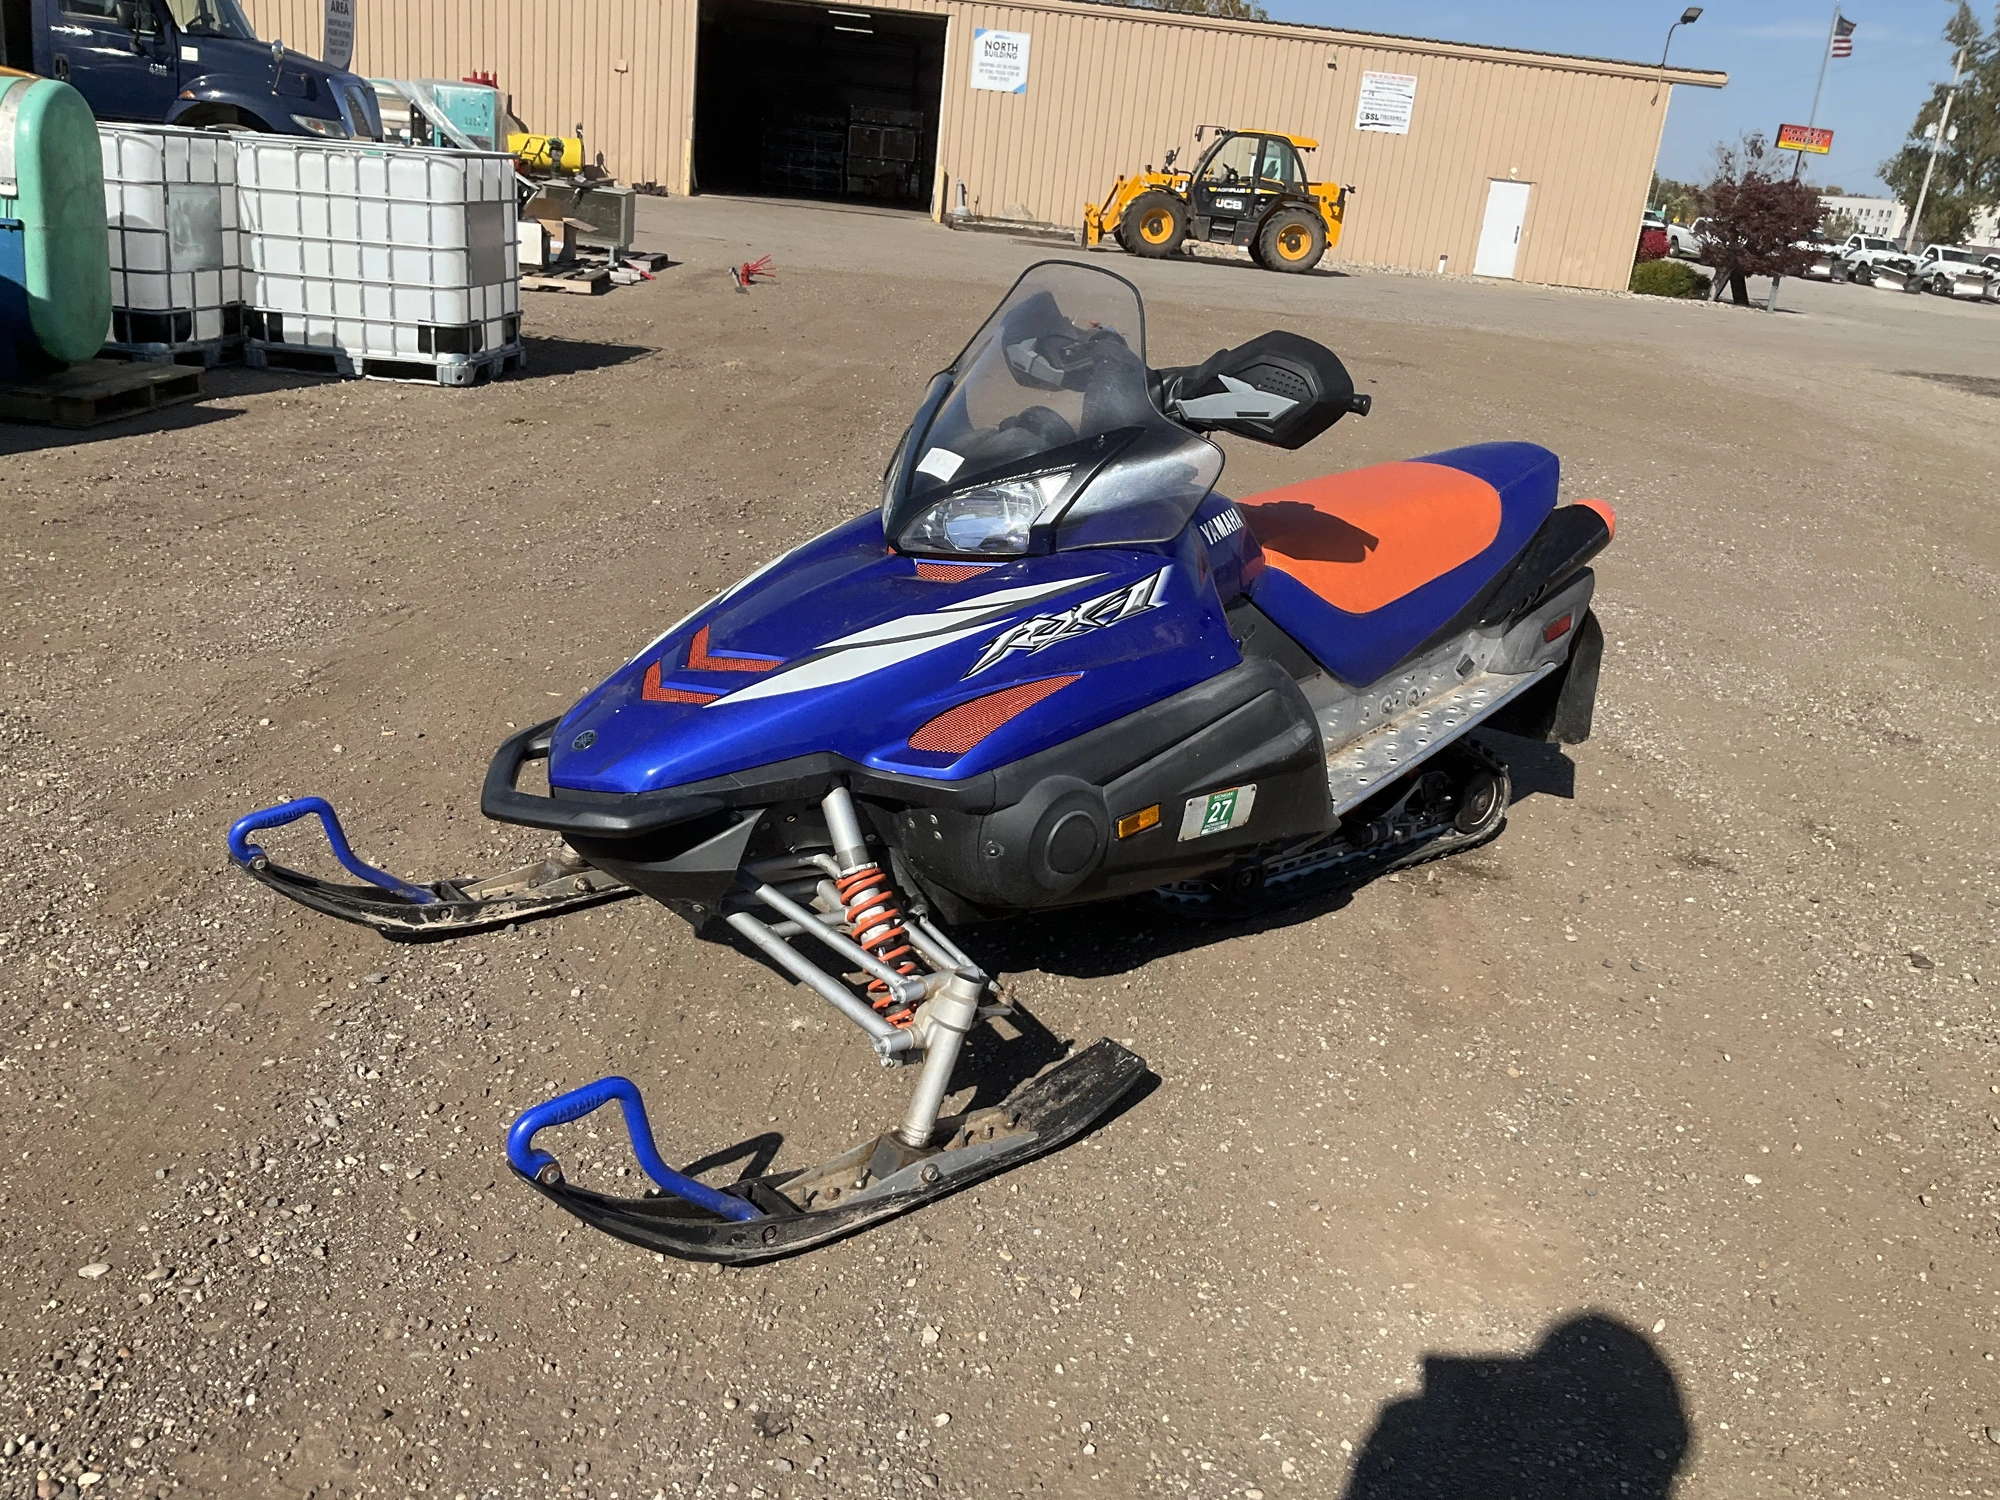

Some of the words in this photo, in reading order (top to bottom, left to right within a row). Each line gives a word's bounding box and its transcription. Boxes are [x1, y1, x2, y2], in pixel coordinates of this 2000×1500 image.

[330, 0, 350, 15] AREA
[985, 40, 1019, 52] NORTH
[984, 50, 1018, 60] BUILDING
[1365, 112, 1379, 121] SSL
[1784, 127, 1830, 139] PACFIC
[1215, 198, 1243, 210] JCB
[1199, 507, 1244, 546] YAMAHA
[1207, 799, 1233, 823] 27
[551, 1093, 604, 1122] YAMAHA
